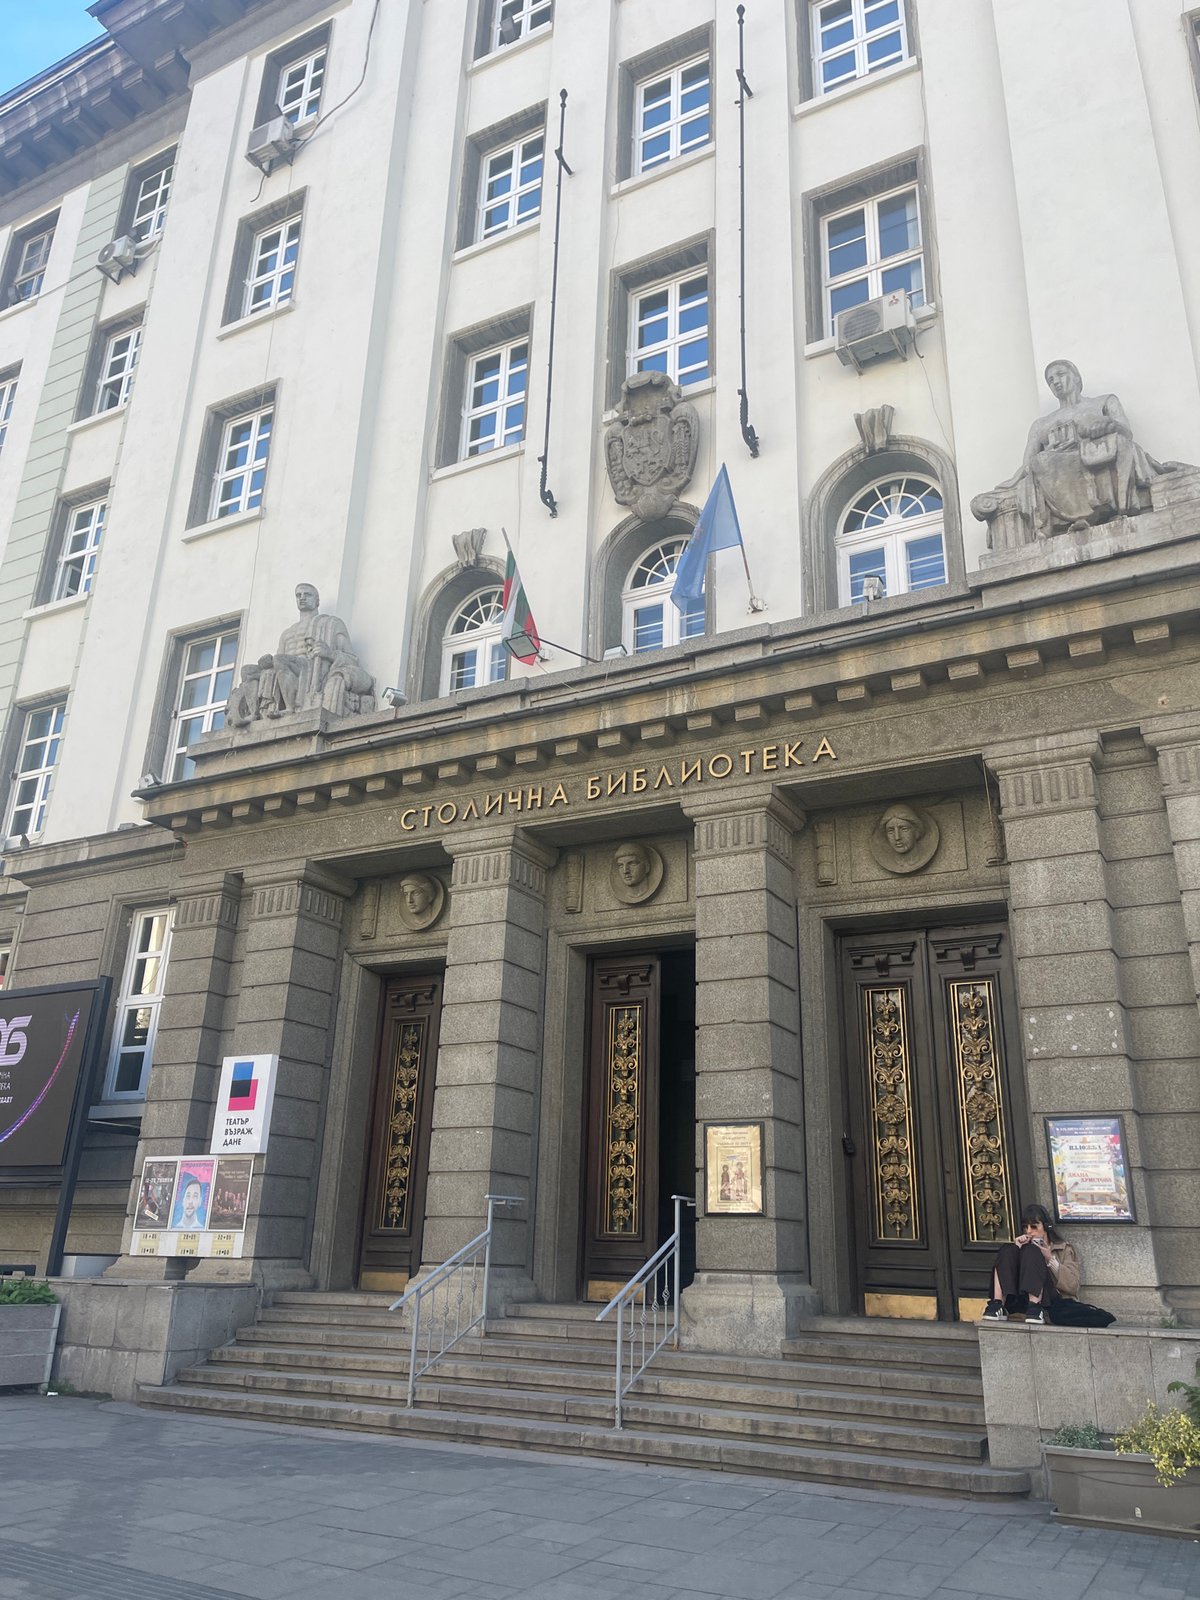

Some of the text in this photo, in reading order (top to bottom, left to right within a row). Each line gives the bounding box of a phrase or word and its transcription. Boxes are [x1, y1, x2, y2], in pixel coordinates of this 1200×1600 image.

[400, 735, 838, 832] СТОЛИЧНА БИБЛИОТЕКА
[226, 1117, 250, 1126] ТЕАТЪР
[224, 1127, 253, 1136] ВЪЗРАЖ
[222, 1138, 242, 1147] ДАНЕ
